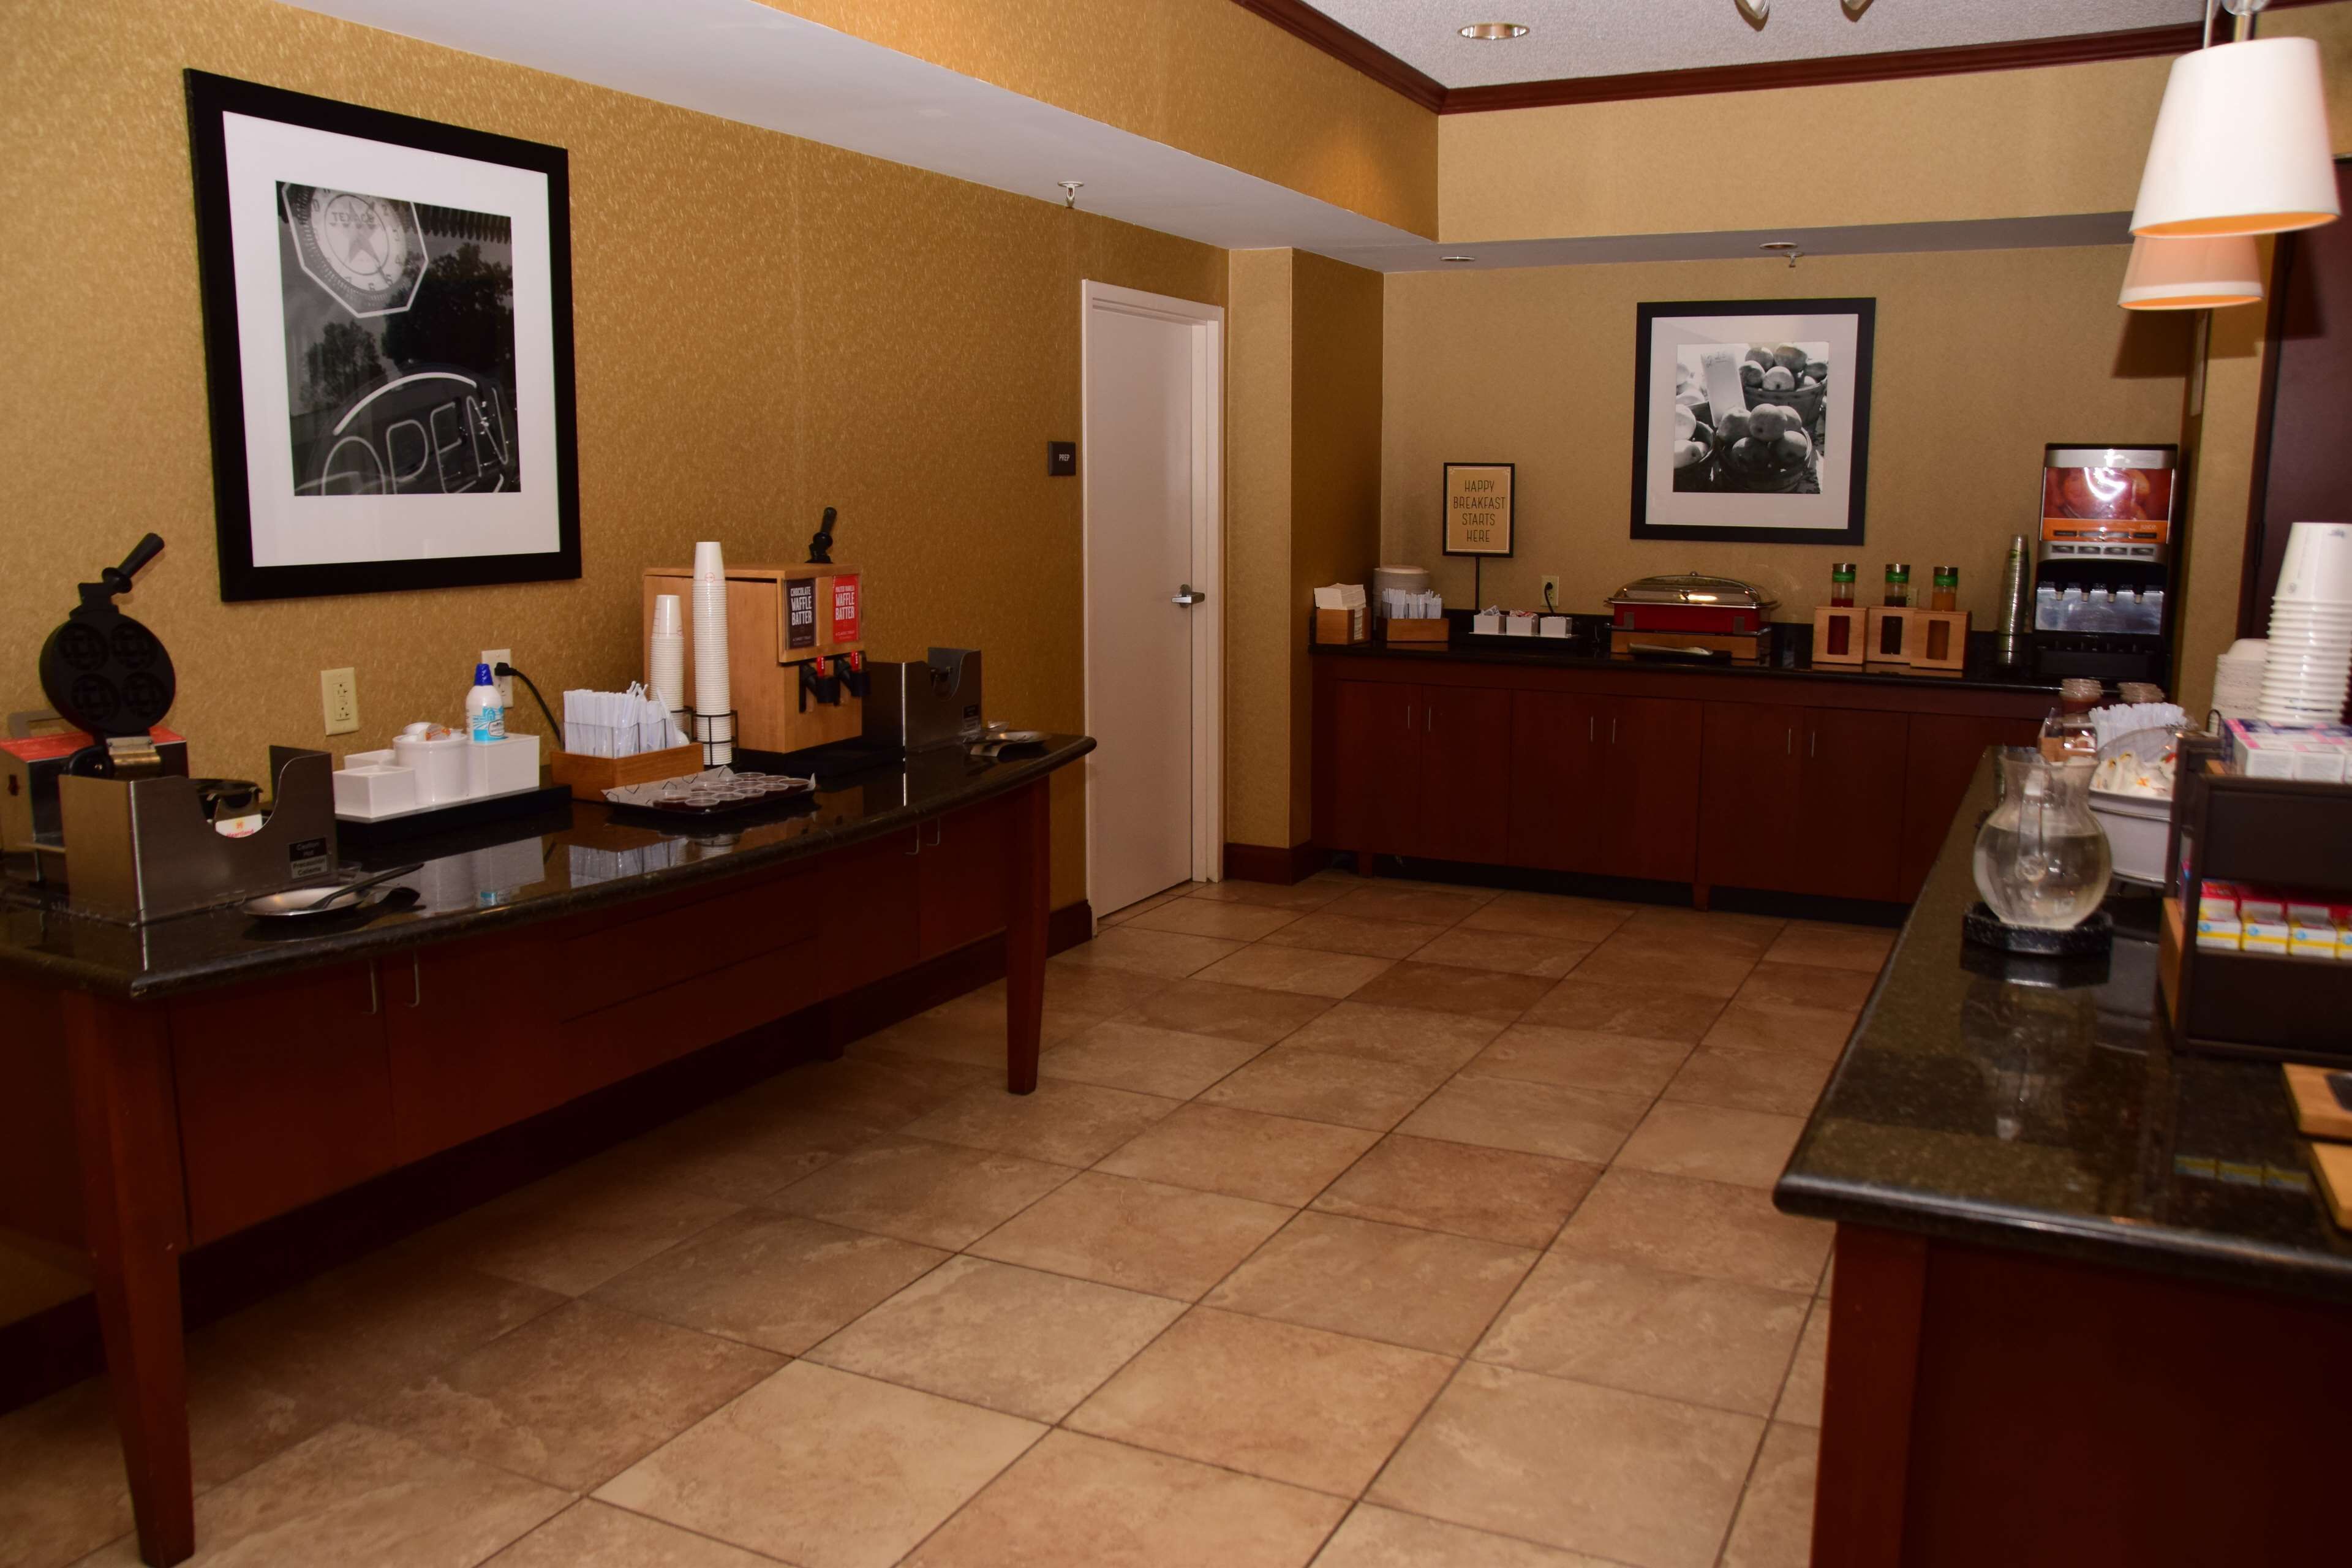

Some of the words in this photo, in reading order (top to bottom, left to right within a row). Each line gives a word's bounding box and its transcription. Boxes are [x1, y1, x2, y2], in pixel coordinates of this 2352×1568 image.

[322, 387, 508, 496] OPEN
[1464, 480, 1494, 492] HAPPY
[1453, 496, 1506, 510] BREAKFAST
[1462, 513, 1495, 526] STARTS
[1466, 529, 1490, 543] HERE
[790, 586, 811, 597] CHOCOLATE
[791, 596, 812, 611] WAFFLE
[835, 592, 855, 606] WAFFLE
[791, 611, 813, 626] BATTER
[835, 606, 855, 620] BATTER
